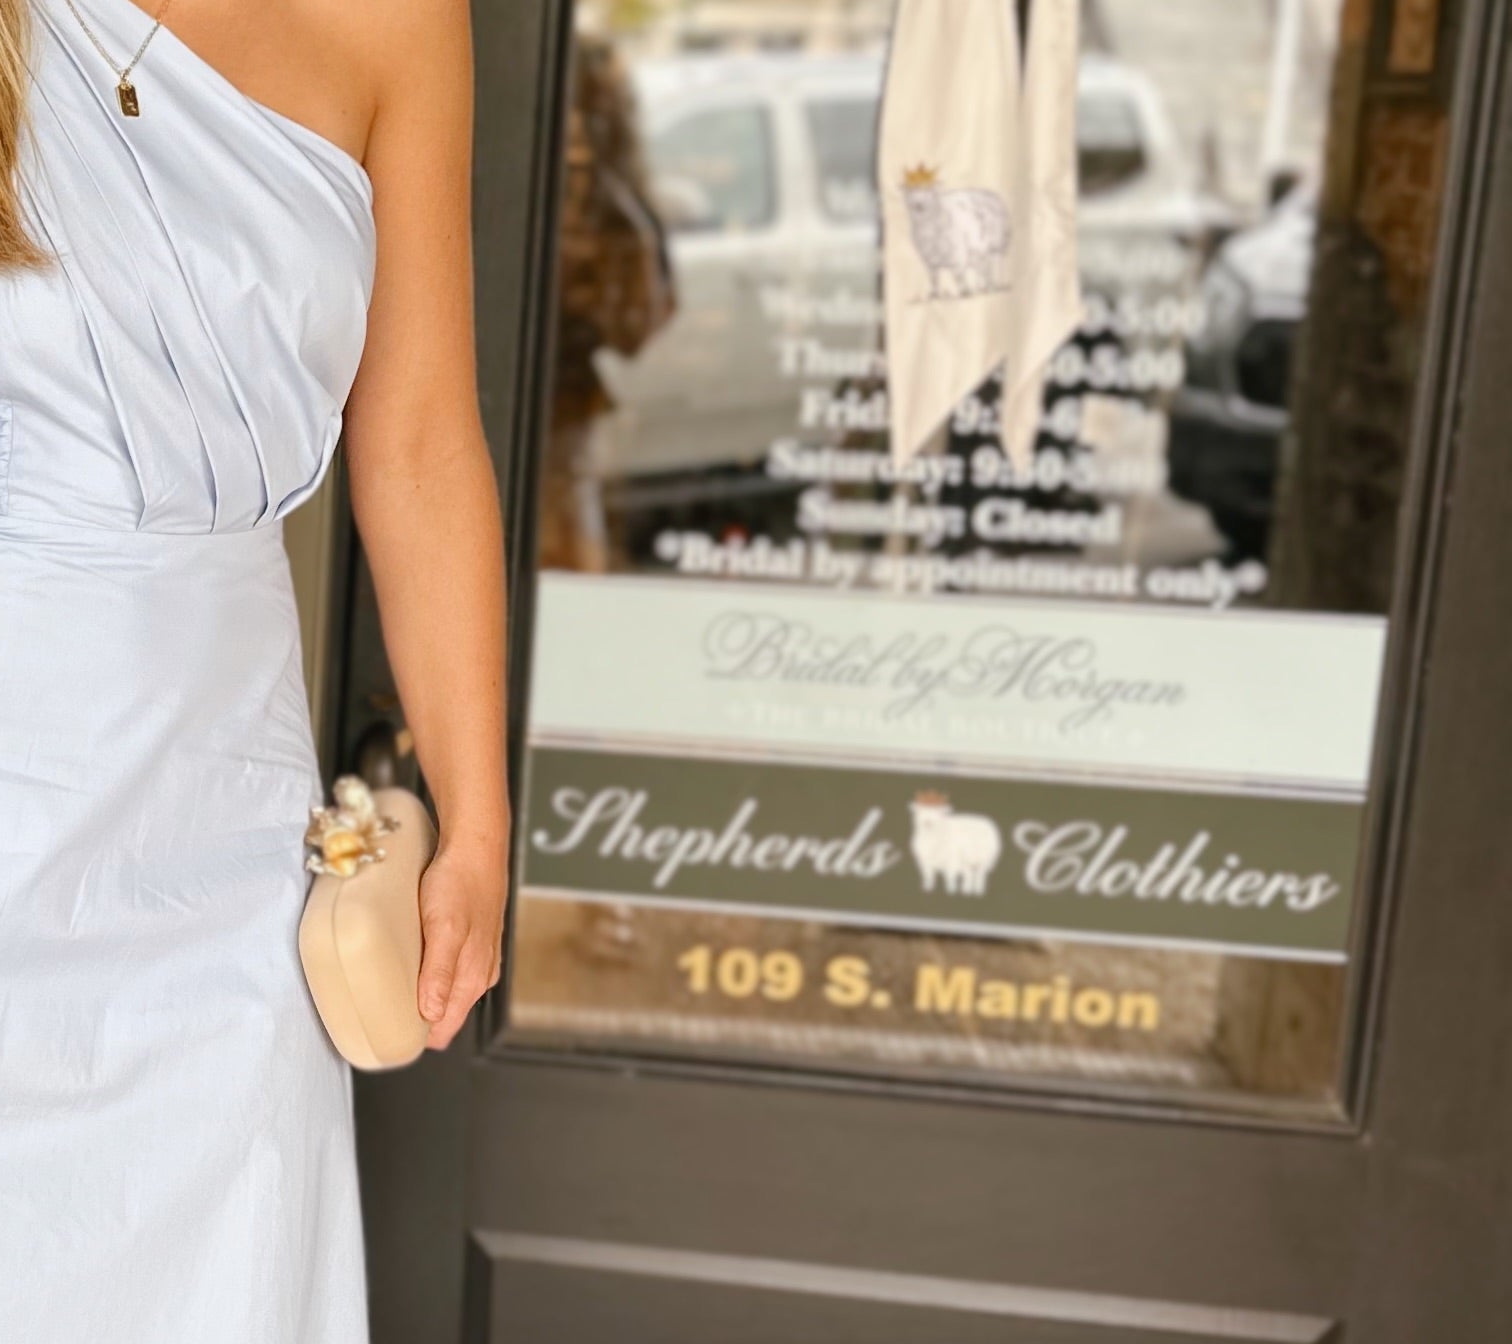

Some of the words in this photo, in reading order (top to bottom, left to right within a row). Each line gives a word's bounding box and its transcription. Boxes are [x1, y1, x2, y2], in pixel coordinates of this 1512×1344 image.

[795, 486, 966, 548] Sunday:
[971, 497, 1123, 546] Closed
[811, 536, 863, 593] by
[870, 546, 1137, 598] appointment
[701, 610, 900, 688] Bridal
[884, 630, 949, 722] by
[943, 623, 1187, 734] Morgan
[531, 785, 900, 889] Shepherds
[1012, 820, 1340, 911] Clothiers
[678, 945, 805, 1002] 109
[823, 955, 892, 1010] S.
[913, 963, 1161, 1031] Marion
